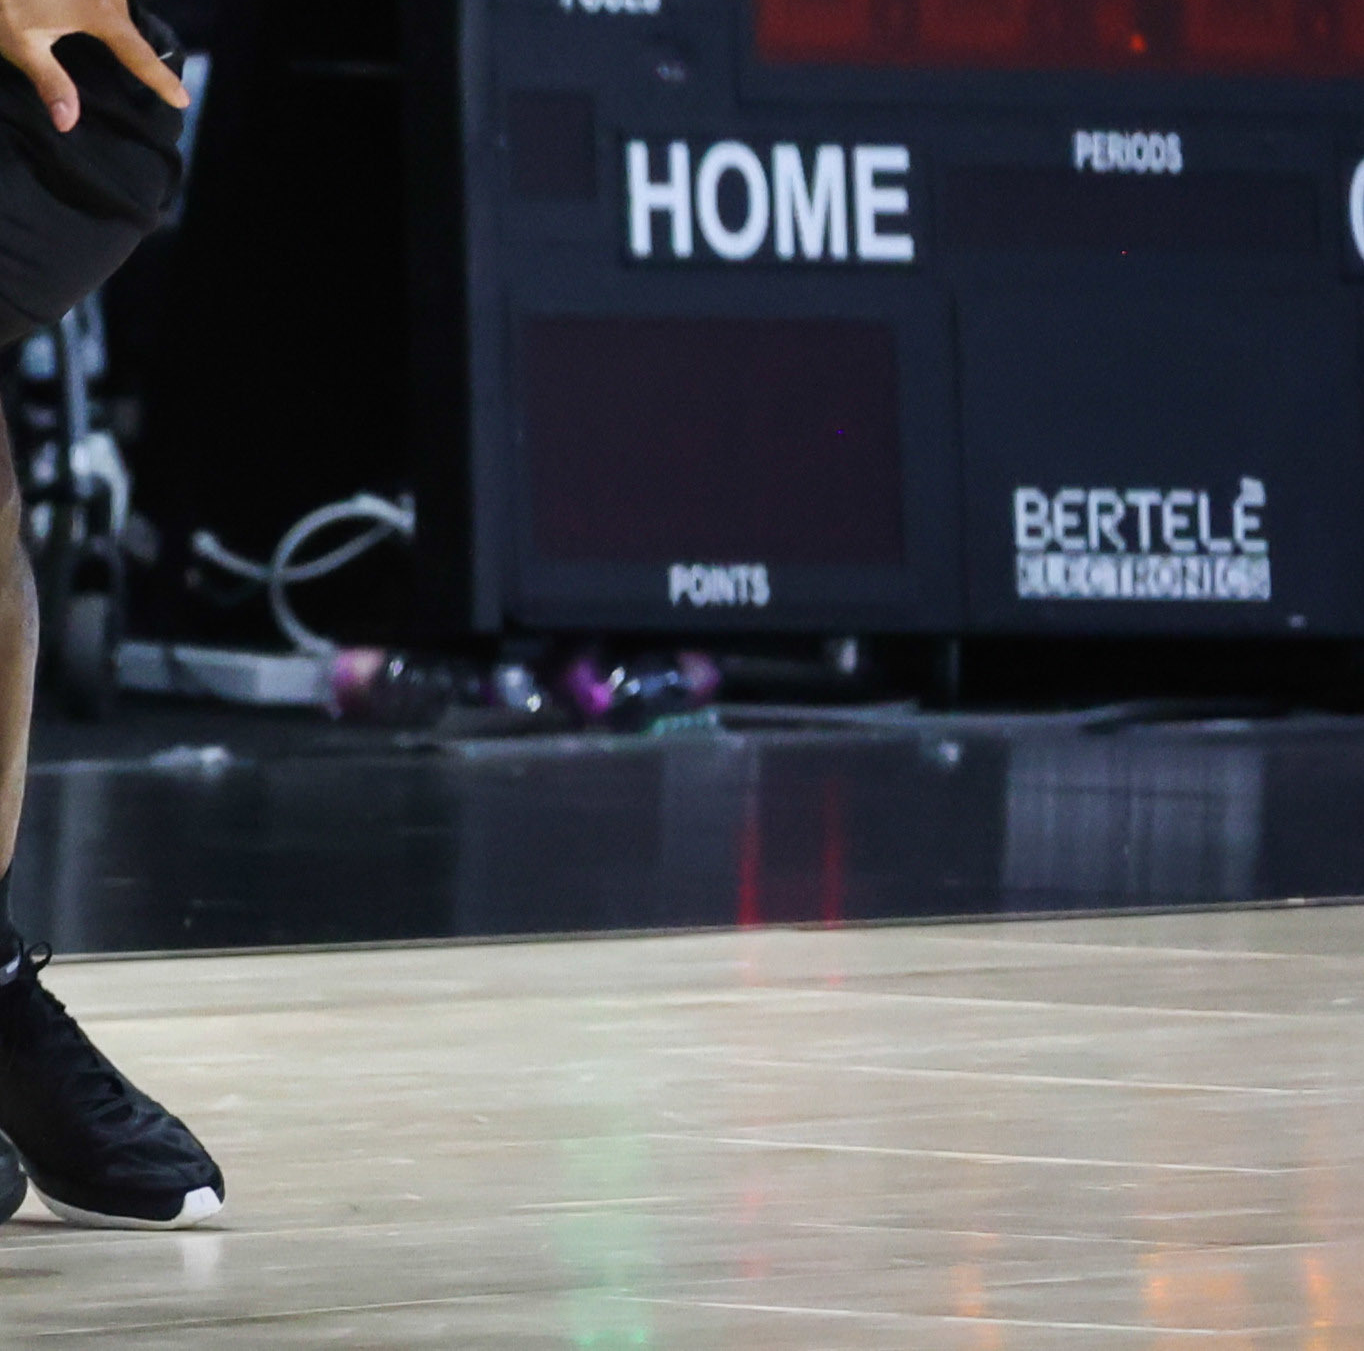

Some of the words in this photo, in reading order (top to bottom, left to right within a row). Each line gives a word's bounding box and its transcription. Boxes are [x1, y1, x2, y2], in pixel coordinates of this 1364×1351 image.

[1073, 130, 1183, 174] PERIODS
[626, 139, 915, 261] HOME
[668, 562, 771, 607] POINTS
